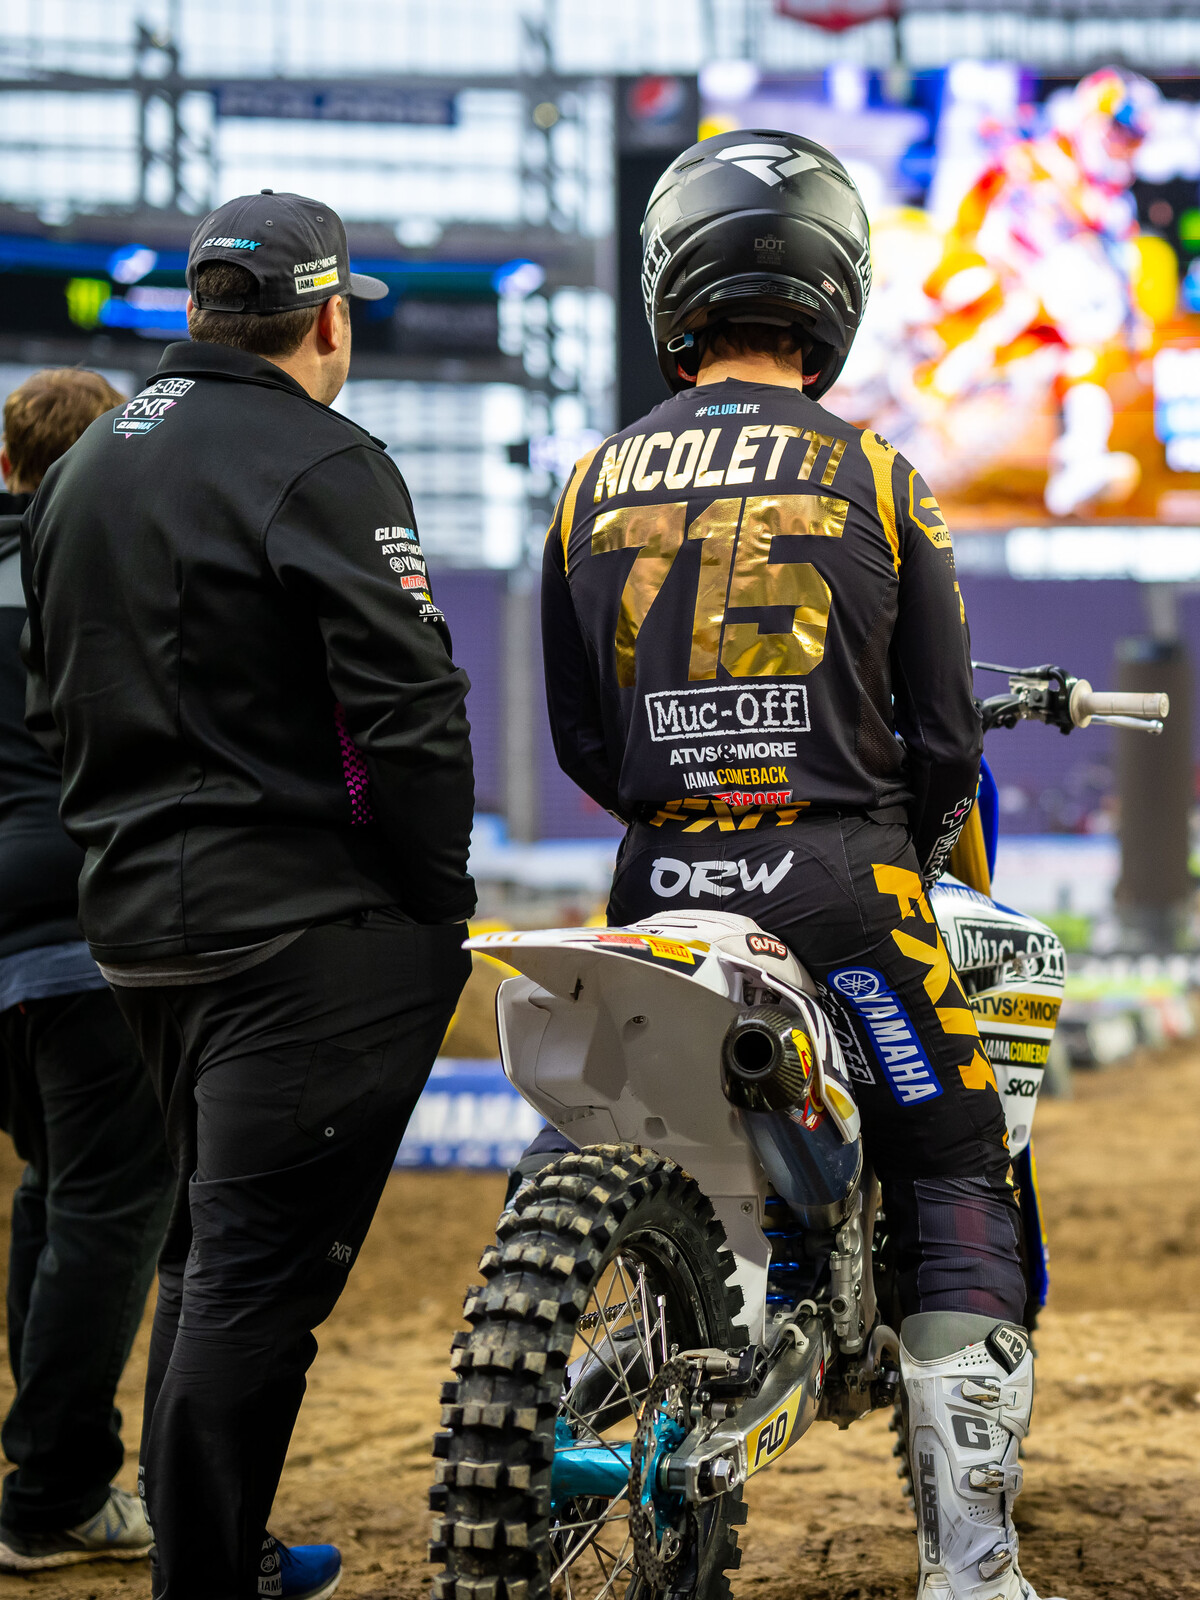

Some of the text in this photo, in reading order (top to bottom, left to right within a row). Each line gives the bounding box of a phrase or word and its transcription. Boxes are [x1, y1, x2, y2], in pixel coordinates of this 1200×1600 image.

[201, 237, 262, 251] CLUBMX
[754, 239, 785, 250] DOT
[121, 398, 175, 416] FXR
[695, 403, 760, 417] #CLUBLIFE
[593, 424, 849, 504] NICOLETTI
[591, 495, 850, 689] 715
[653, 690, 801, 734] Muc-Off
[669, 741, 798, 766] ATVS&MORE
[682, 766, 789, 790] IAMACOMEBACK
[649, 850, 795, 899] ORW
[650, 940, 690, 960] PIRELLI
[751, 935, 786, 957] GUTS
[854, 988, 938, 1104] YAMAHA
[754, 1409, 789, 1468] FLO
